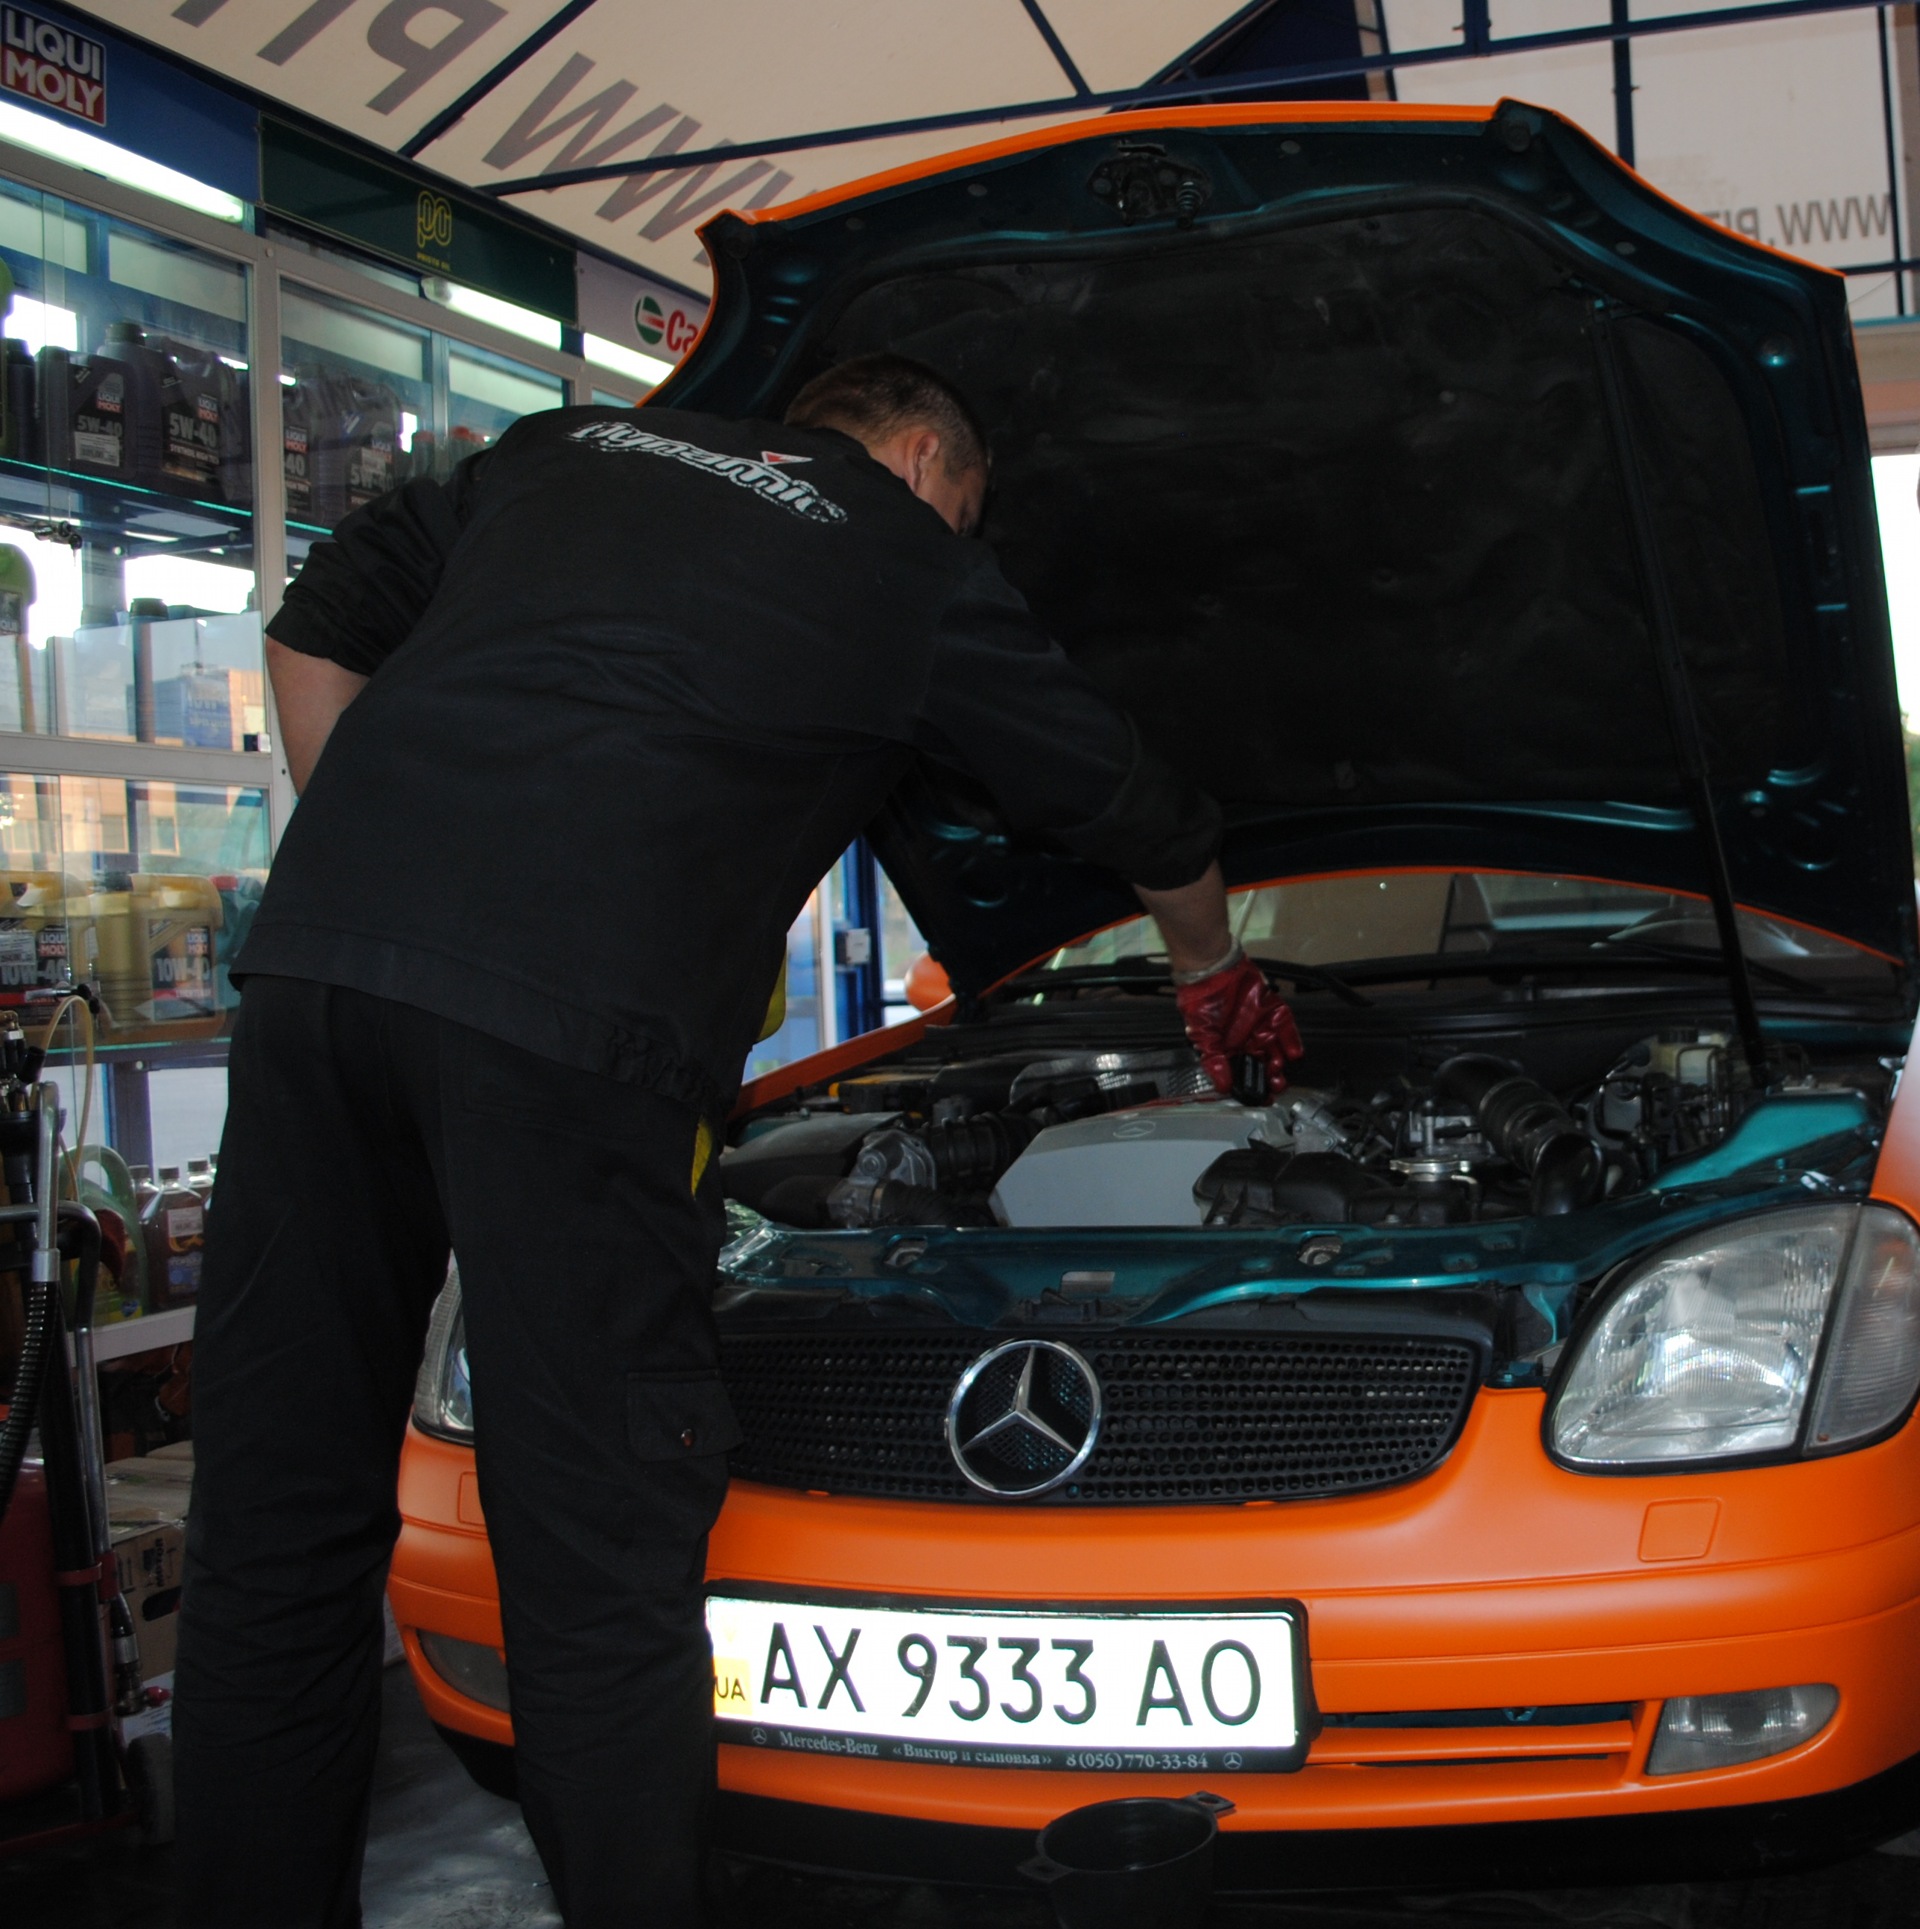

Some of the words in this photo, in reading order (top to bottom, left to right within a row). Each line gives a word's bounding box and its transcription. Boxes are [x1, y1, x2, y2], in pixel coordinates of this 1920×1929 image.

[6, 8, 101, 81] LIQUI
[6, 48, 103, 117] MOLY
[169, 412, 217, 448] 5W-40
[715, 1676, 746, 1702] UA
[760, 1622, 867, 1713] AX
[897, 1633, 1097, 1725] 9333
[1136, 1640, 1261, 1726] AO
[780, 1730, 879, 1756] Mercedes-Benz
[892, 1743, 958, 1763] «Виктор
